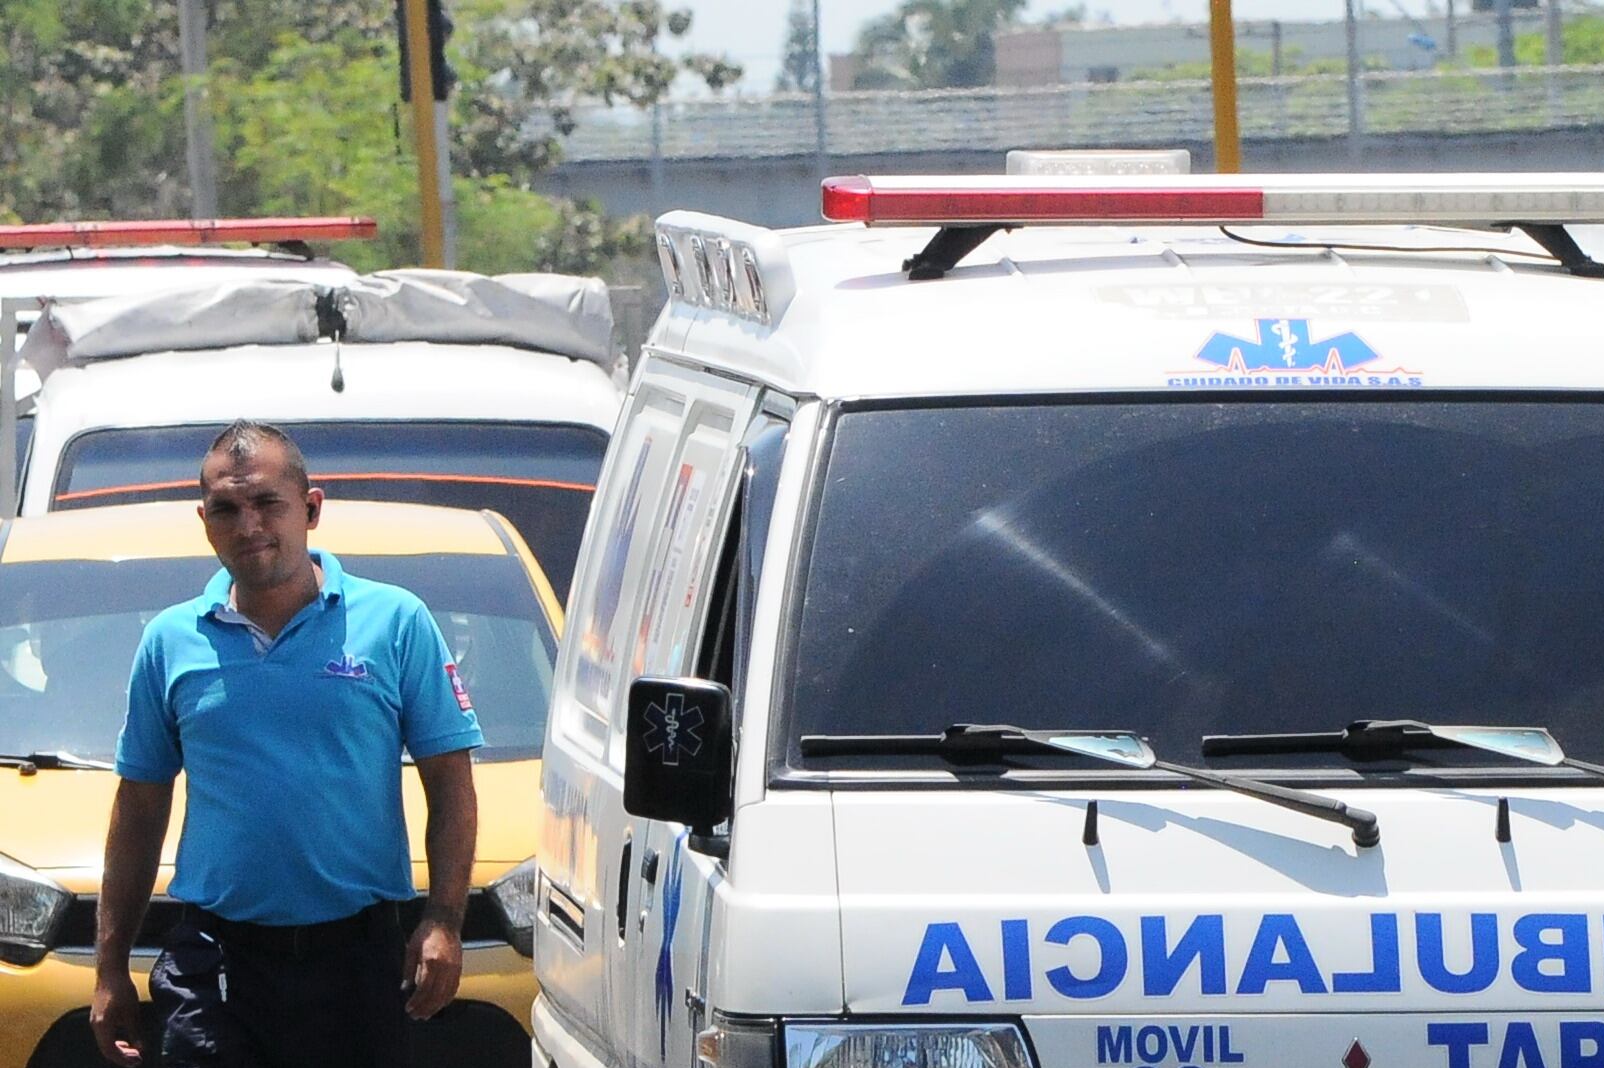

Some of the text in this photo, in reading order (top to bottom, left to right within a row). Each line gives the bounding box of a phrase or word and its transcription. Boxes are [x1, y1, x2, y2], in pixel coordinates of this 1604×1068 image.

[1167, 376, 1268, 386] CUIDADO
[1276, 376, 1302, 385] DE
[1308, 376, 1361, 385] VIDA
[1097, 1025, 1244, 1063] MOVIL
